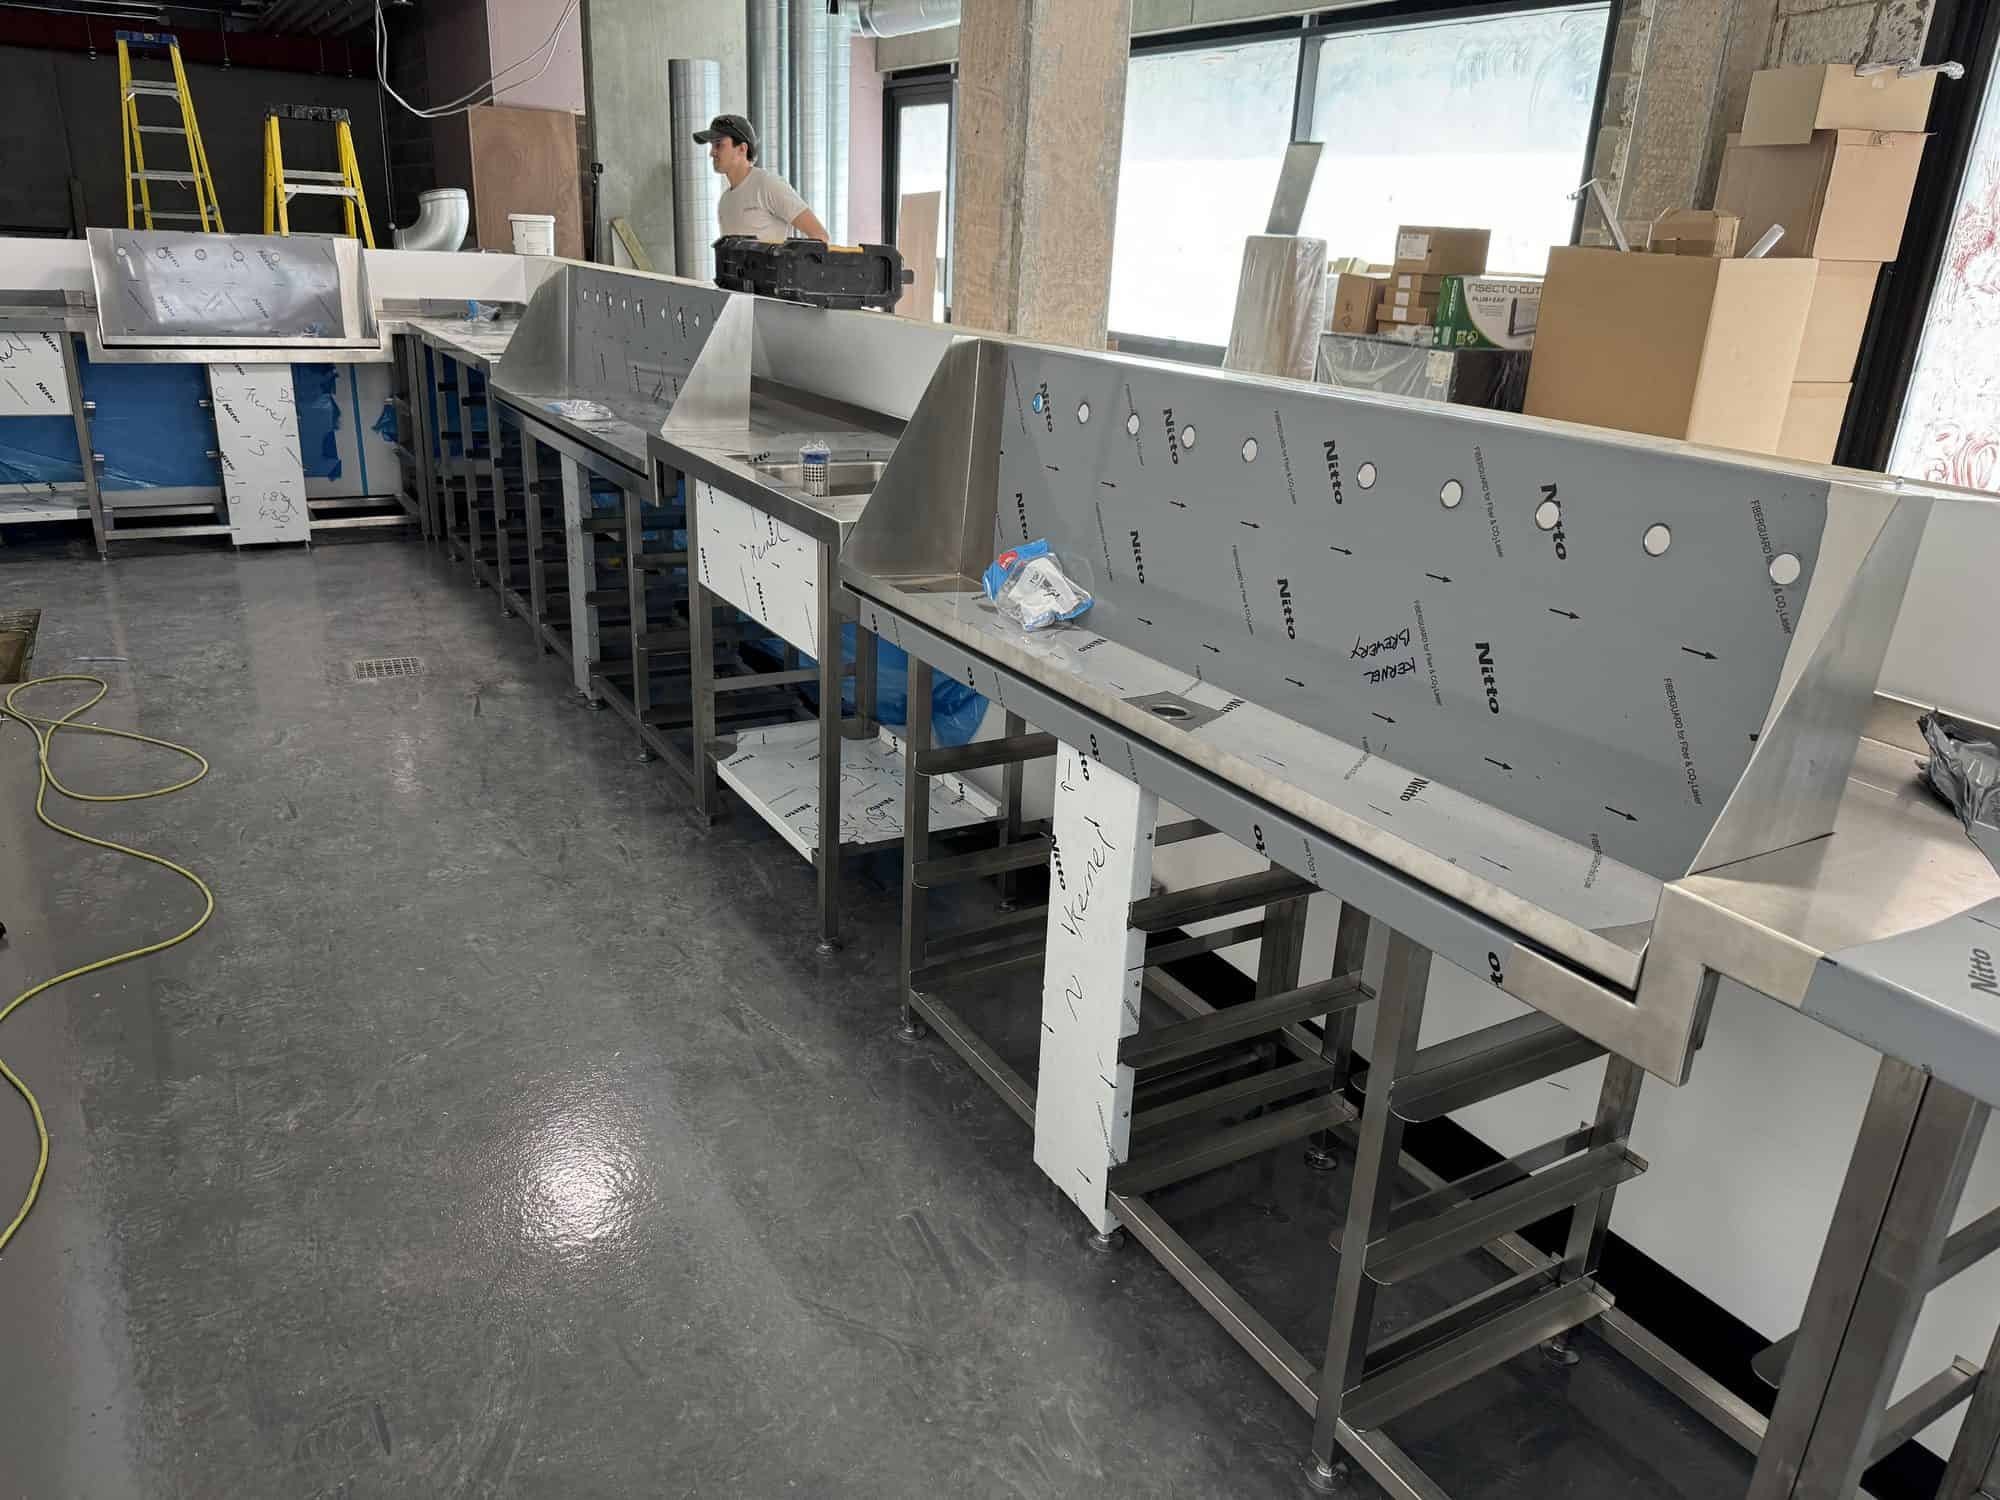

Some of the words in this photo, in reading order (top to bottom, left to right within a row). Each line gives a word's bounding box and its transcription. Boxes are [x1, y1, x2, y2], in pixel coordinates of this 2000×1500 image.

[1163, 408, 1178, 464] Nitto
[1324, 440, 1342, 505] Nitto
[1016, 493, 1028, 540] Nitto
[1750, 499, 1772, 554] FIBERGUARD
[1130, 530, 1144, 584] Nitto
[1277, 579, 1295, 640] Nitto
[1350, 627, 1411, 659] BREWERY
[1363, 657, 1416, 684] KERNEL
[1474, 642, 1499, 715] Nitto
[1663, 678, 1683, 729] FIBERGUARD
[1400, 777, 1430, 801] Nitto
[1968, 948, 2000, 997] Nitto
